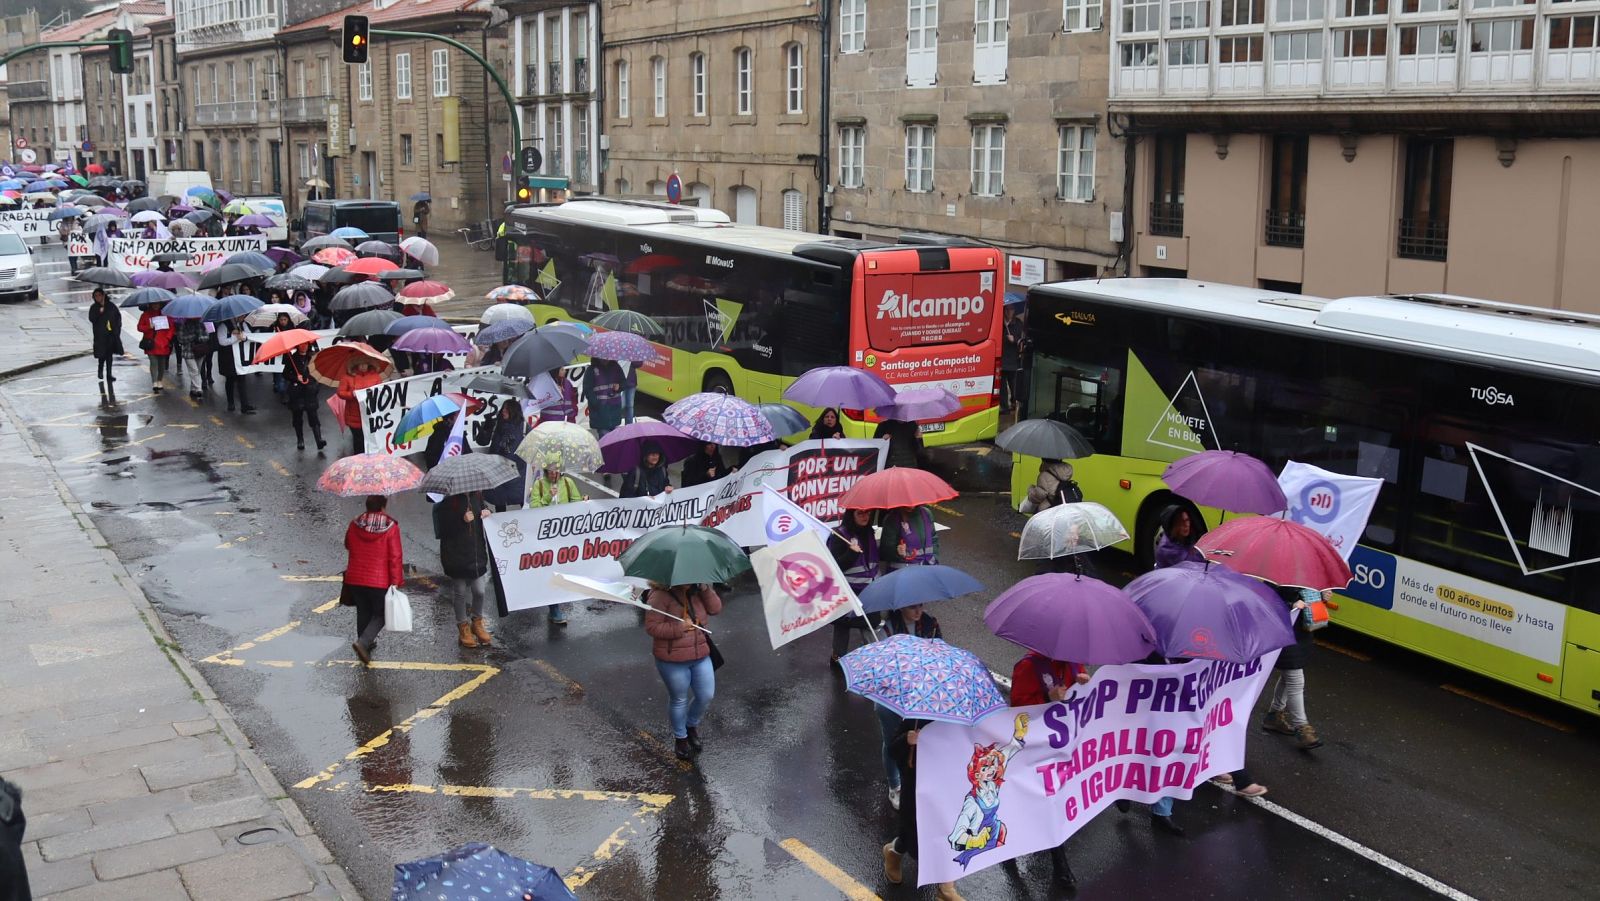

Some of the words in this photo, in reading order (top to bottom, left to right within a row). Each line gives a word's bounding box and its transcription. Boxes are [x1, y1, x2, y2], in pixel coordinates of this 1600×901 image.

[24, 222, 37, 232] EN
[70, 232, 87, 243] POR
[70, 244, 88, 254] CIG
[112, 240, 197, 254] LIMPADORAS
[201, 241, 214, 252] da
[217, 239, 261, 251] XUNTA
[876, 289, 985, 320] Alcampo
[880, 360, 920, 371] Santiago
[921, 358, 932, 367] de
[933, 354, 981, 368] Compostela
[365, 381, 409, 415] NON
[1470, 386, 1515, 406] TUSSA
[369, 412, 394, 434] LOS
[1167, 411, 1205, 430] MÓVETE
[1168, 427, 1180, 439] EN
[1183, 430, 1201, 443] BUS
[798, 457, 828, 478] POR
[833, 456, 859, 471] UN
[537, 507, 632, 540] EDUCACIÓN
[633, 497, 701, 529] INFANTIL
[519, 550, 554, 570] non
[557, 545, 579, 565] ao
[582, 537, 635, 562] bloqu
[1354, 563, 1386, 589] SO
[1400, 591, 1428, 607] donde
[1429, 601, 1438, 611] el
[1440, 602, 1468, 620] futuro
[1469, 614, 1487, 627] nos
[1489, 618, 1512, 634] lleve
[1401, 576, 1420, 590] Más
[1422, 583, 1434, 594] de
[1439, 587, 1456, 600] 100
[1457, 592, 1481, 608] años
[1482, 600, 1513, 618] juntos
[1517, 612, 1524, 623] y
[1525, 613, 1554, 631] hasta
[1043, 678, 1118, 749] STOP
[1036, 727, 1176, 797] TRABALLO
[1065, 796, 1078, 822] e
